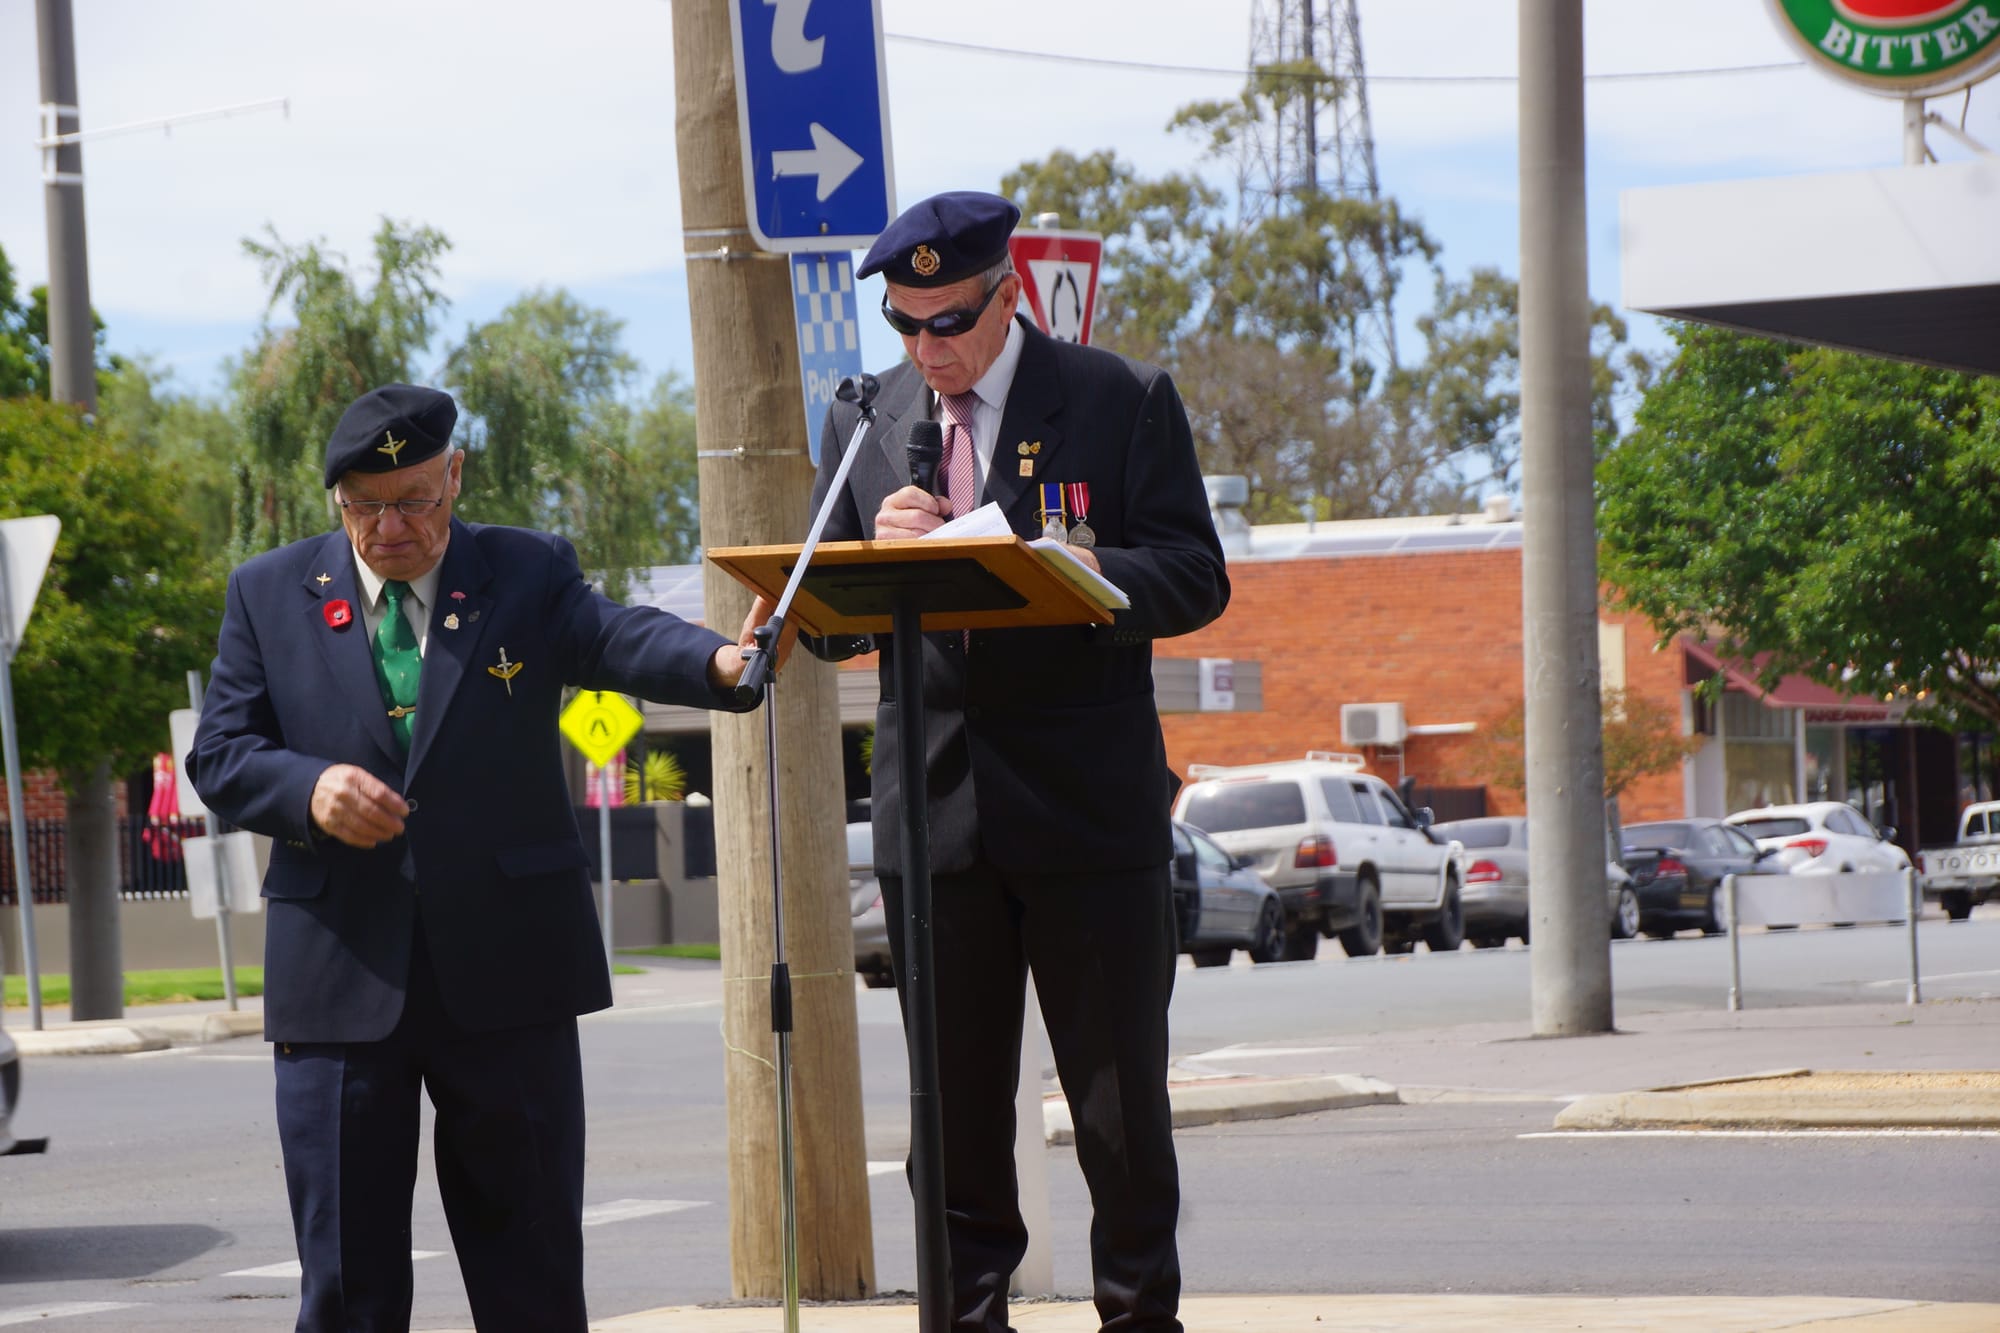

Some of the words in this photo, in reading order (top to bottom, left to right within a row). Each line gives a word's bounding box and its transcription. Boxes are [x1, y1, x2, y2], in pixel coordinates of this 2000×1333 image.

[1820, 6, 2000, 68] BITTER
[807, 368, 860, 405] Poli
[1936, 850, 2000, 871] TOYOT
